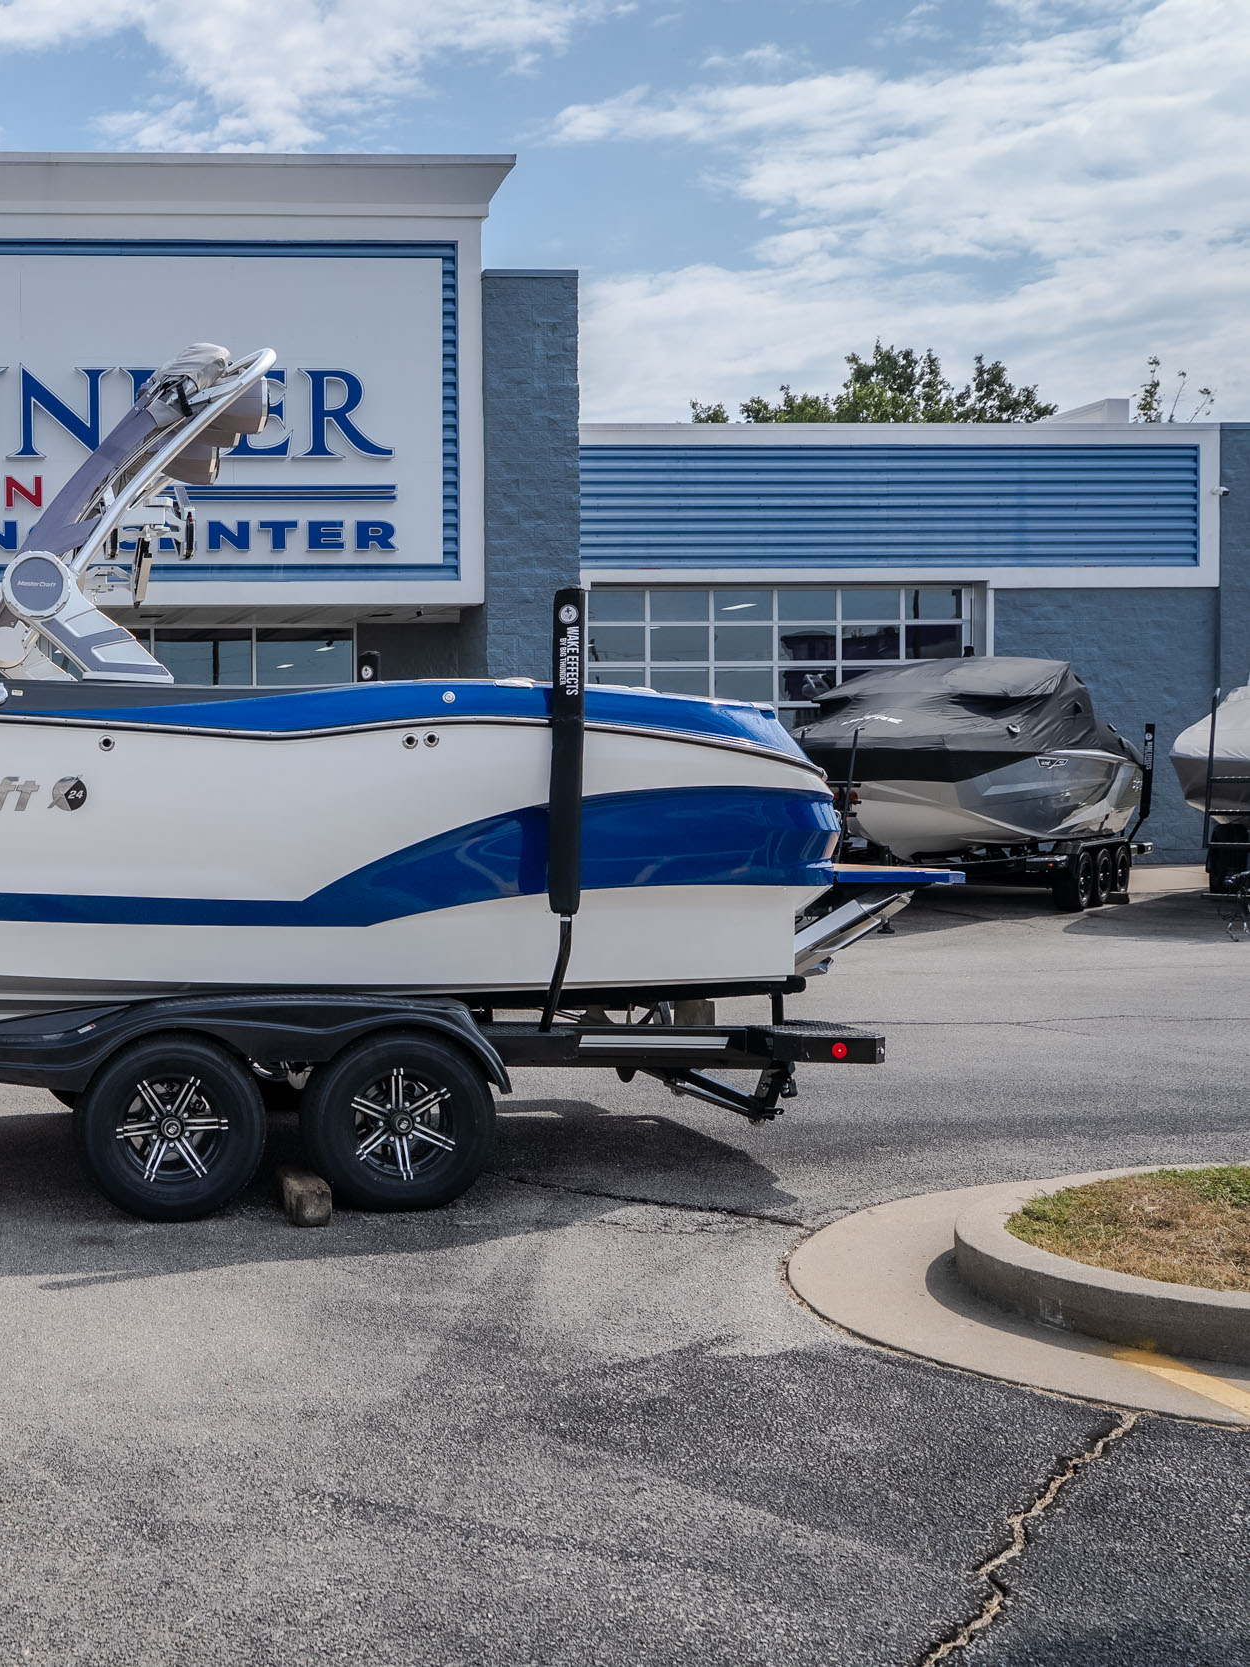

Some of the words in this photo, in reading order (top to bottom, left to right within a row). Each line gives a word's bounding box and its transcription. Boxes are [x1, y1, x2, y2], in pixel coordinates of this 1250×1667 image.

[16, 579, 57, 588] MasterCraft
[559, 637, 567, 646] BY
[566, 626, 580, 654] WAKE
[559, 647, 567, 657] BIG
[559, 657, 567, 686] THUNDER
[565, 655, 580, 696] EFFECTS
